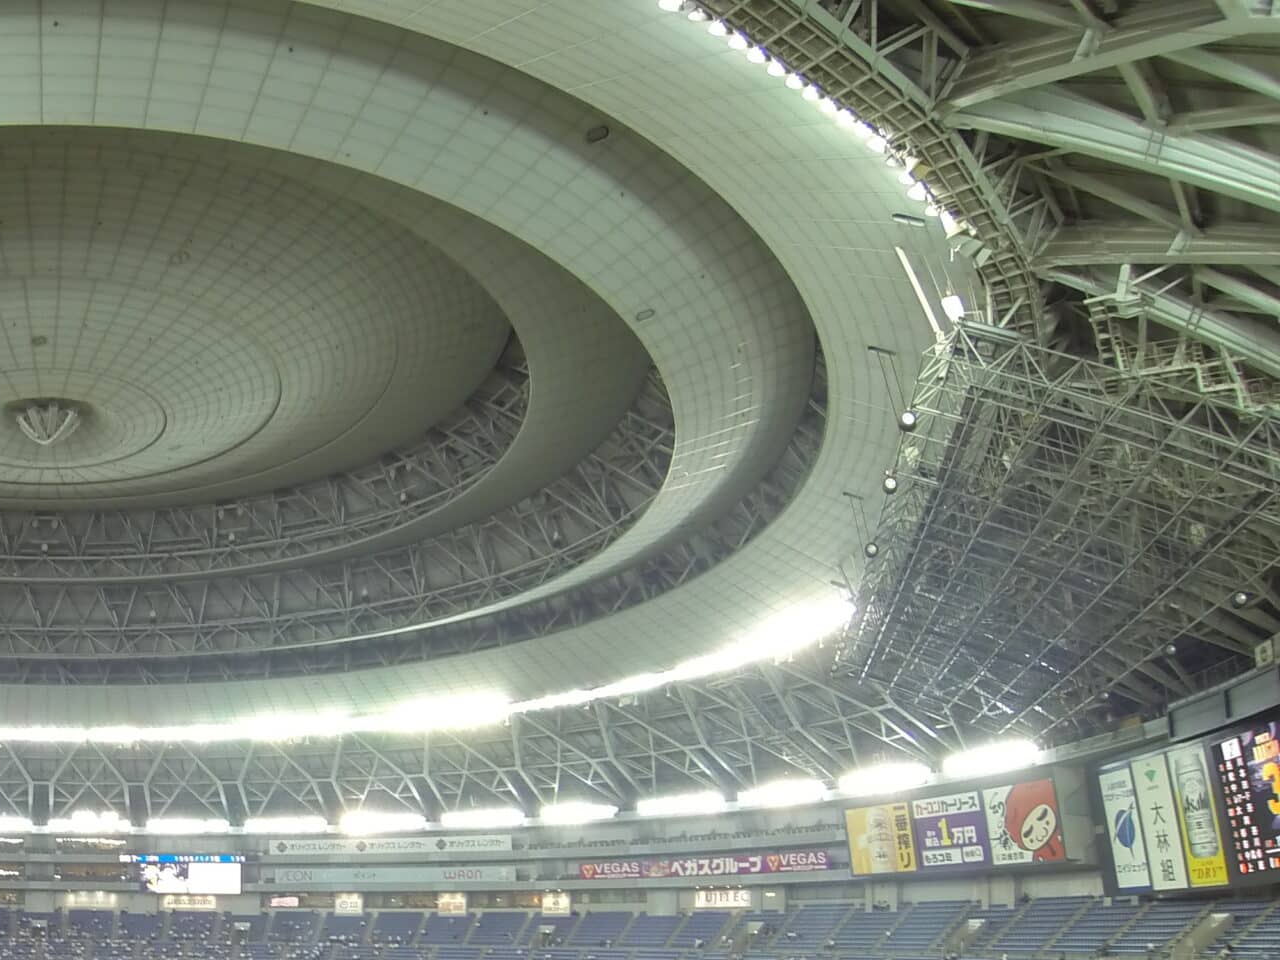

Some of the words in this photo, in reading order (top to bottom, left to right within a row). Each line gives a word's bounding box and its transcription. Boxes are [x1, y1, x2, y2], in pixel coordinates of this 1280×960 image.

[893, 804, 912, 869] 一番搾り
[1150, 801, 1177, 882] 大林組
[594, 862, 640, 873] VEGAS
[671, 856, 762, 876] ベガスグループ
[779, 852, 827, 865] VEGAS
